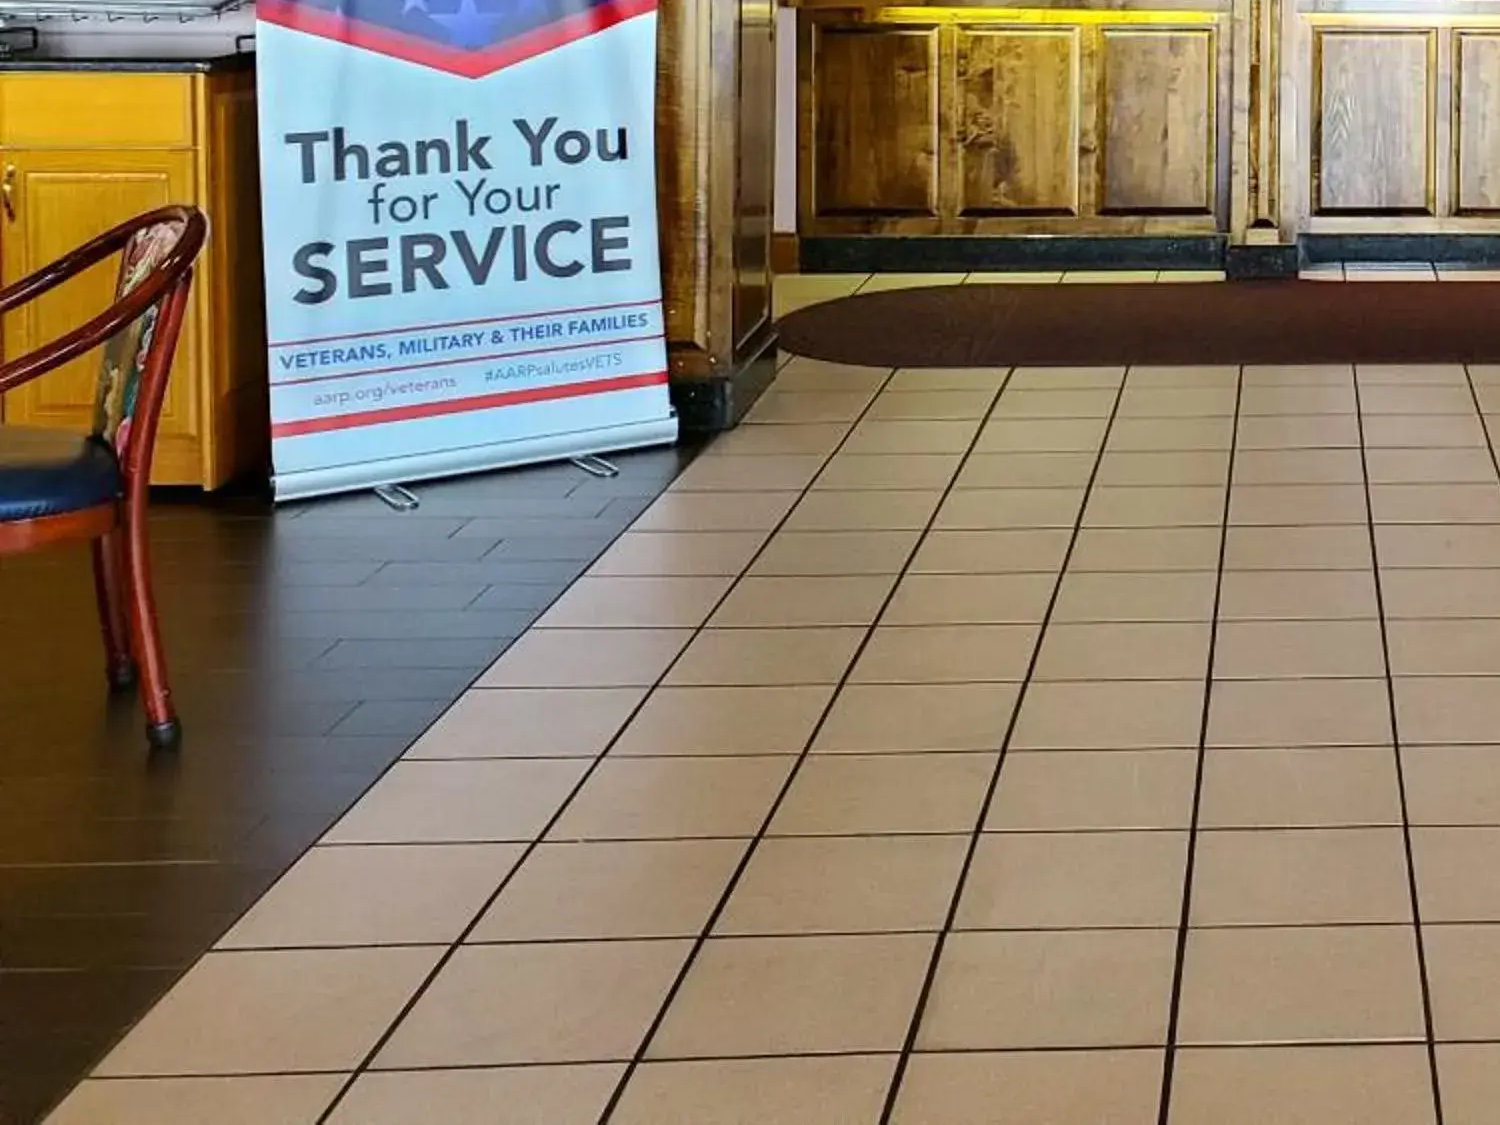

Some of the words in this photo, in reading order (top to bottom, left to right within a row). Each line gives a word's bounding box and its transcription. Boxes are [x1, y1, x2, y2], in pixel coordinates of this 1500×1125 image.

[284, 119, 493, 184] Thank
[513, 116, 629, 166] You
[367, 183, 438, 224] for
[456, 178, 561, 216] Your
[292, 216, 632, 305] SERVICE
[279, 342, 391, 370] VETERANS,
[399, 331, 485, 356] MILITARY
[491, 330, 504, 344] &
[509, 323, 564, 343] THEIR
[568, 312, 650, 336] FAMILIES
